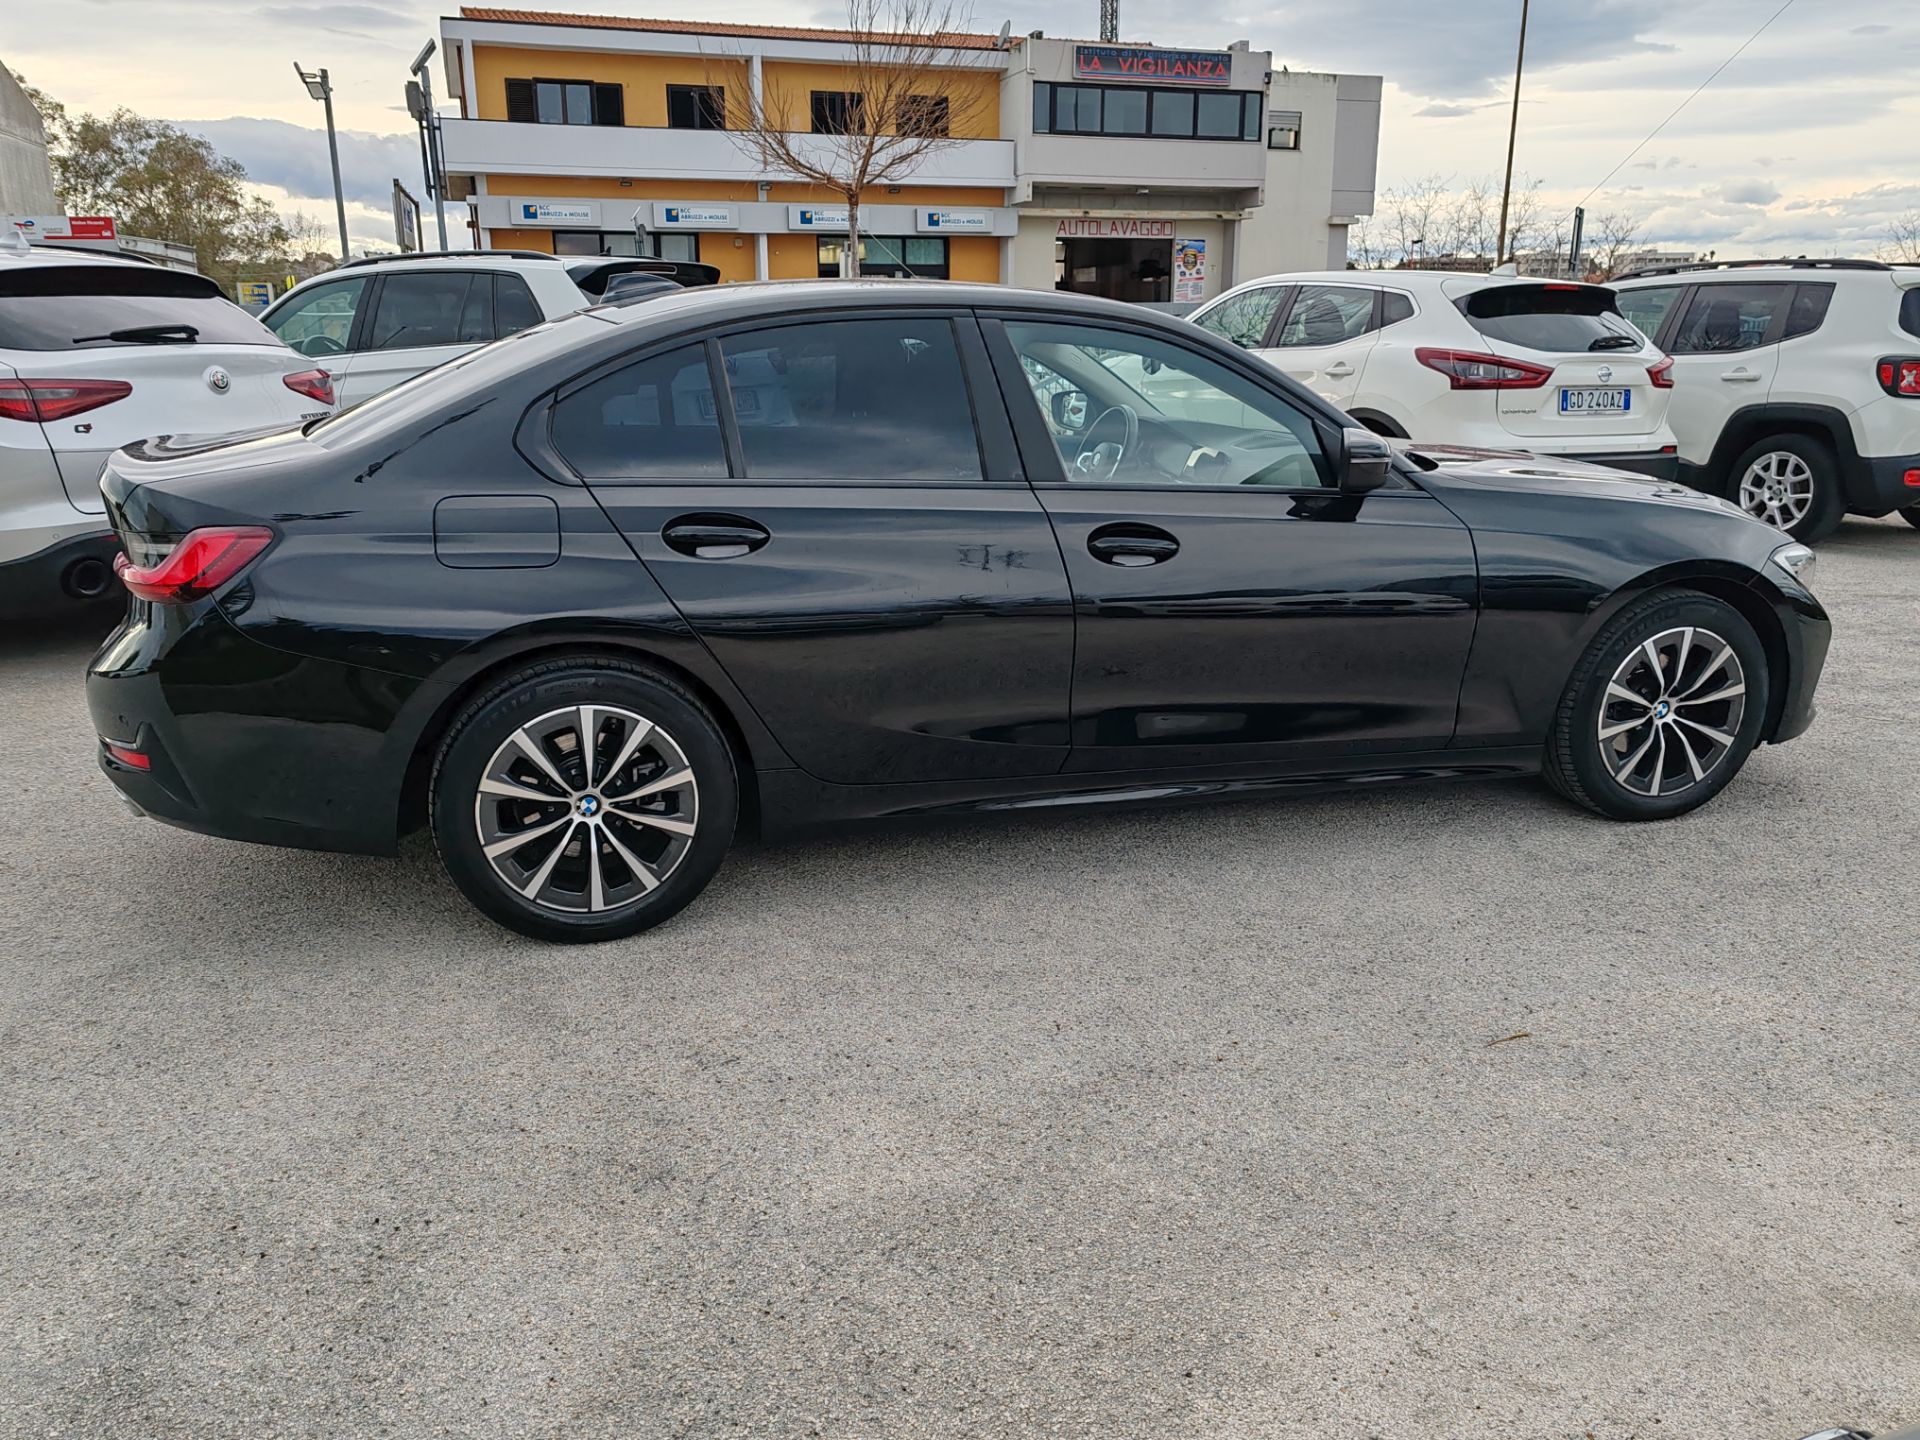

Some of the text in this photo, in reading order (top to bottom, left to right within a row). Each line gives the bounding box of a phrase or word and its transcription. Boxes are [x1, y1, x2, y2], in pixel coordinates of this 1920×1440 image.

[1079, 54, 1227, 78] LA VIGILANZA
[1057, 219, 1174, 236] AUTOLAVAGGIO
